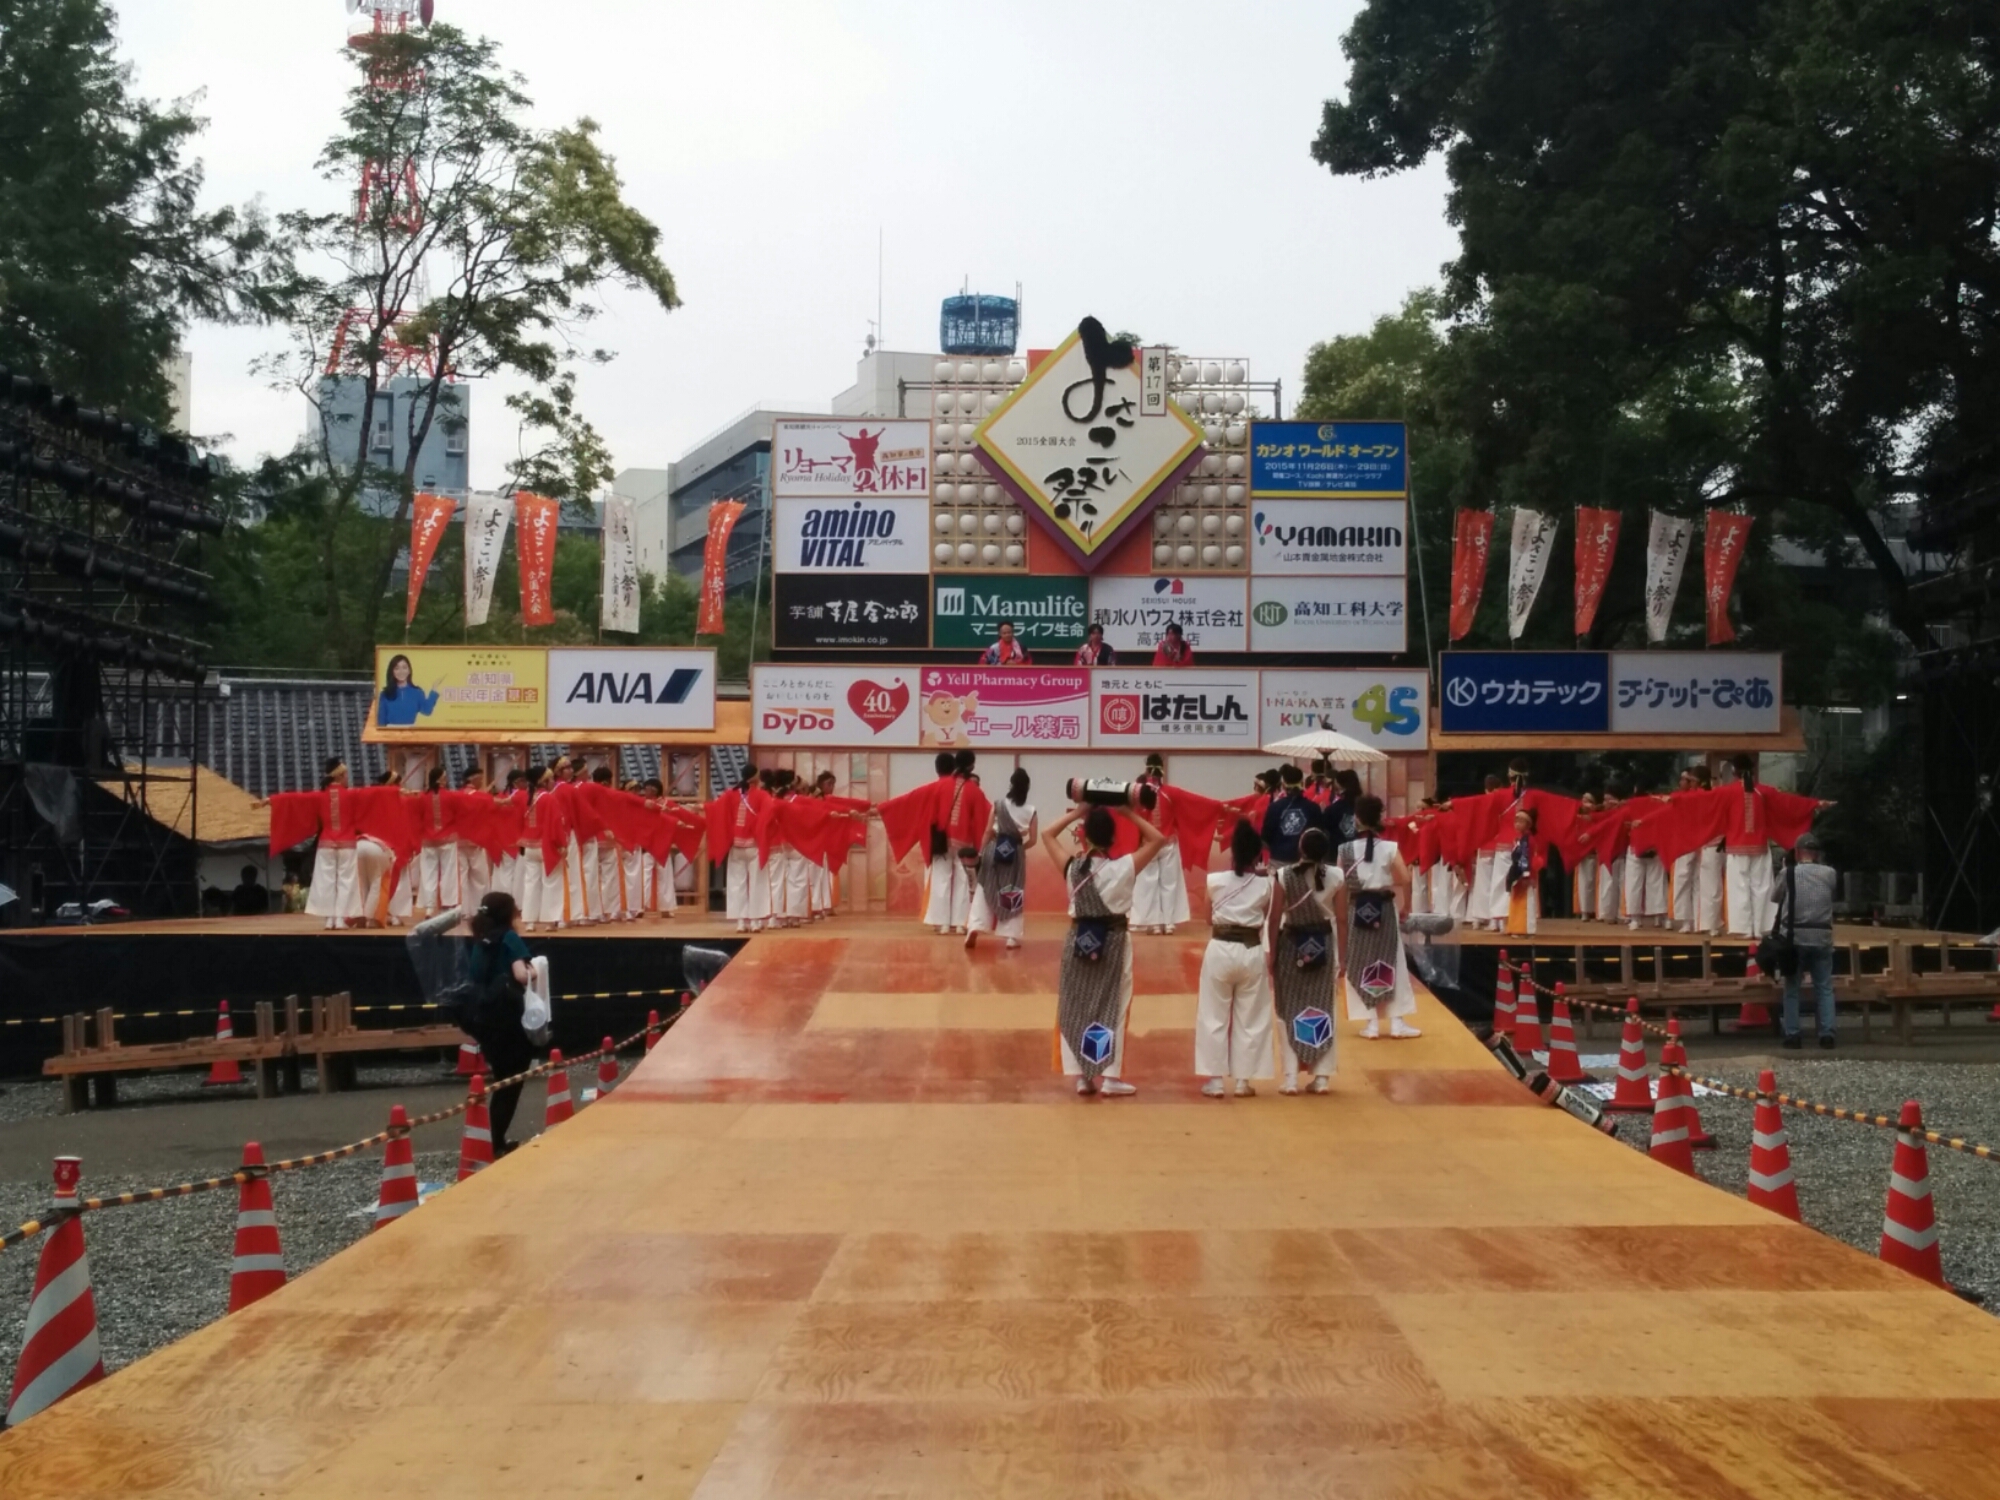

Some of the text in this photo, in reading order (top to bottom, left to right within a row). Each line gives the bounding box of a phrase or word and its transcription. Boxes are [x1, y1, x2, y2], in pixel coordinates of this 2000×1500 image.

[1146, 356, 1161, 407] 第17回
[1016, 436, 1077, 447] 2015全国大会
[1256, 444, 1399, 458] カシオ ワールド オープン
[780, 473, 851, 484] Ryoma Holiday
[784, 448, 926, 492] リョーマの休日
[801, 501, 896, 538] amino
[1275, 526, 1402, 547] YAMAKIN
[800, 539, 865, 567] VITAL
[971, 594, 1085, 618] Manulife
[1294, 601, 1403, 617] 高知工科大学
[1093, 608, 1244, 627] 積水ハウス株式会社
[971, 622, 1084, 637] マニライフ生命
[815, 636, 888, 645] www.imokin.co.jp
[566, 672, 652, 704] ANA
[946, 673, 1082, 689] Yell Pharmacy Group
[1101, 680, 1163, 690] 地元と ともに
[1481, 680, 1601, 705] ウカテック
[1618, 677, 1774, 708] チケットぴあ
[1143, 694, 1248, 721] はたしん
[763, 713, 834, 734] DyDo
[967, 716, 1080, 739] エール薬局
[1280, 713, 1330, 728] KUTV
